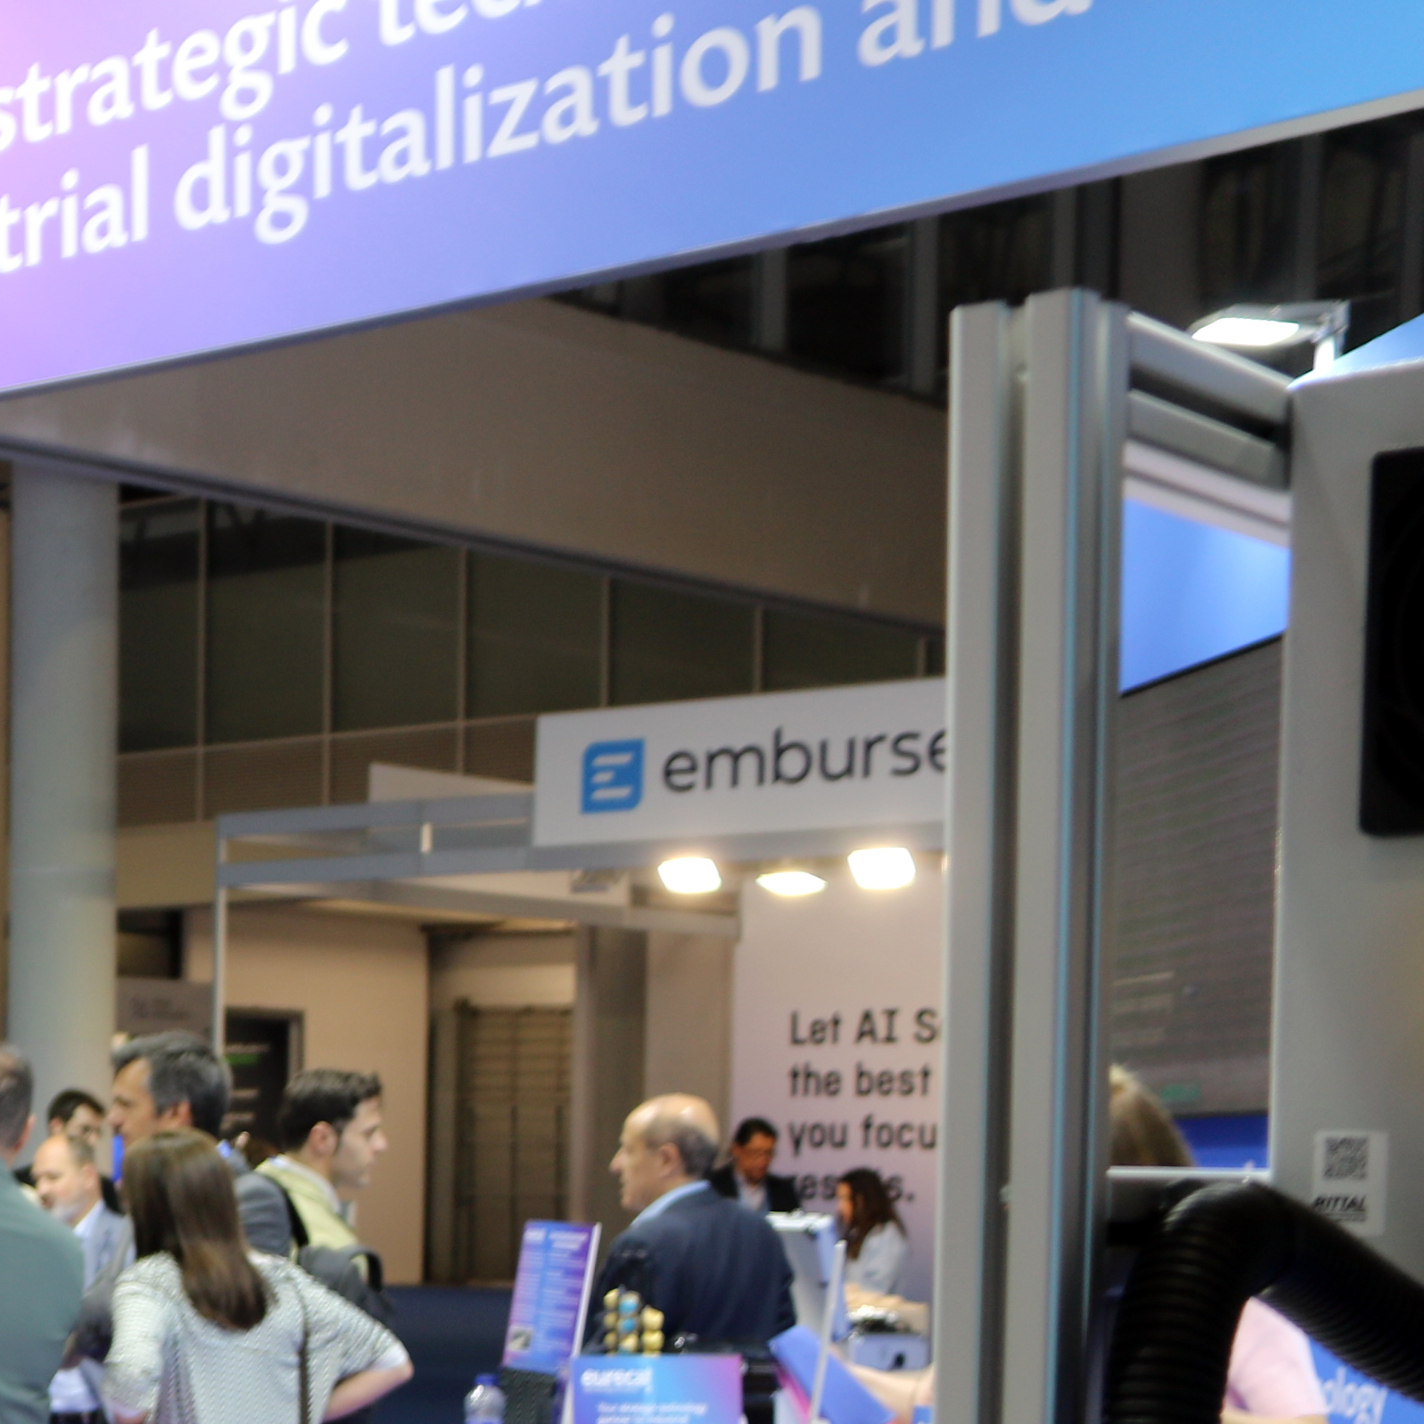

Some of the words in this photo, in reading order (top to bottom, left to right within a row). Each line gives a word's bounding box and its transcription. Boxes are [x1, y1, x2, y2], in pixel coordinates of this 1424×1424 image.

[173, 4, 823, 245] digitalization
[789, 1010, 841, 1045] Let
[856, 1007, 900, 1044] AI
[913, 1008, 943, 1045] S
[789, 1062, 842, 1097] the
[855, 1062, 932, 1097] best
[788, 1121, 848, 1158] you
[862, 1114, 938, 1150] focu
